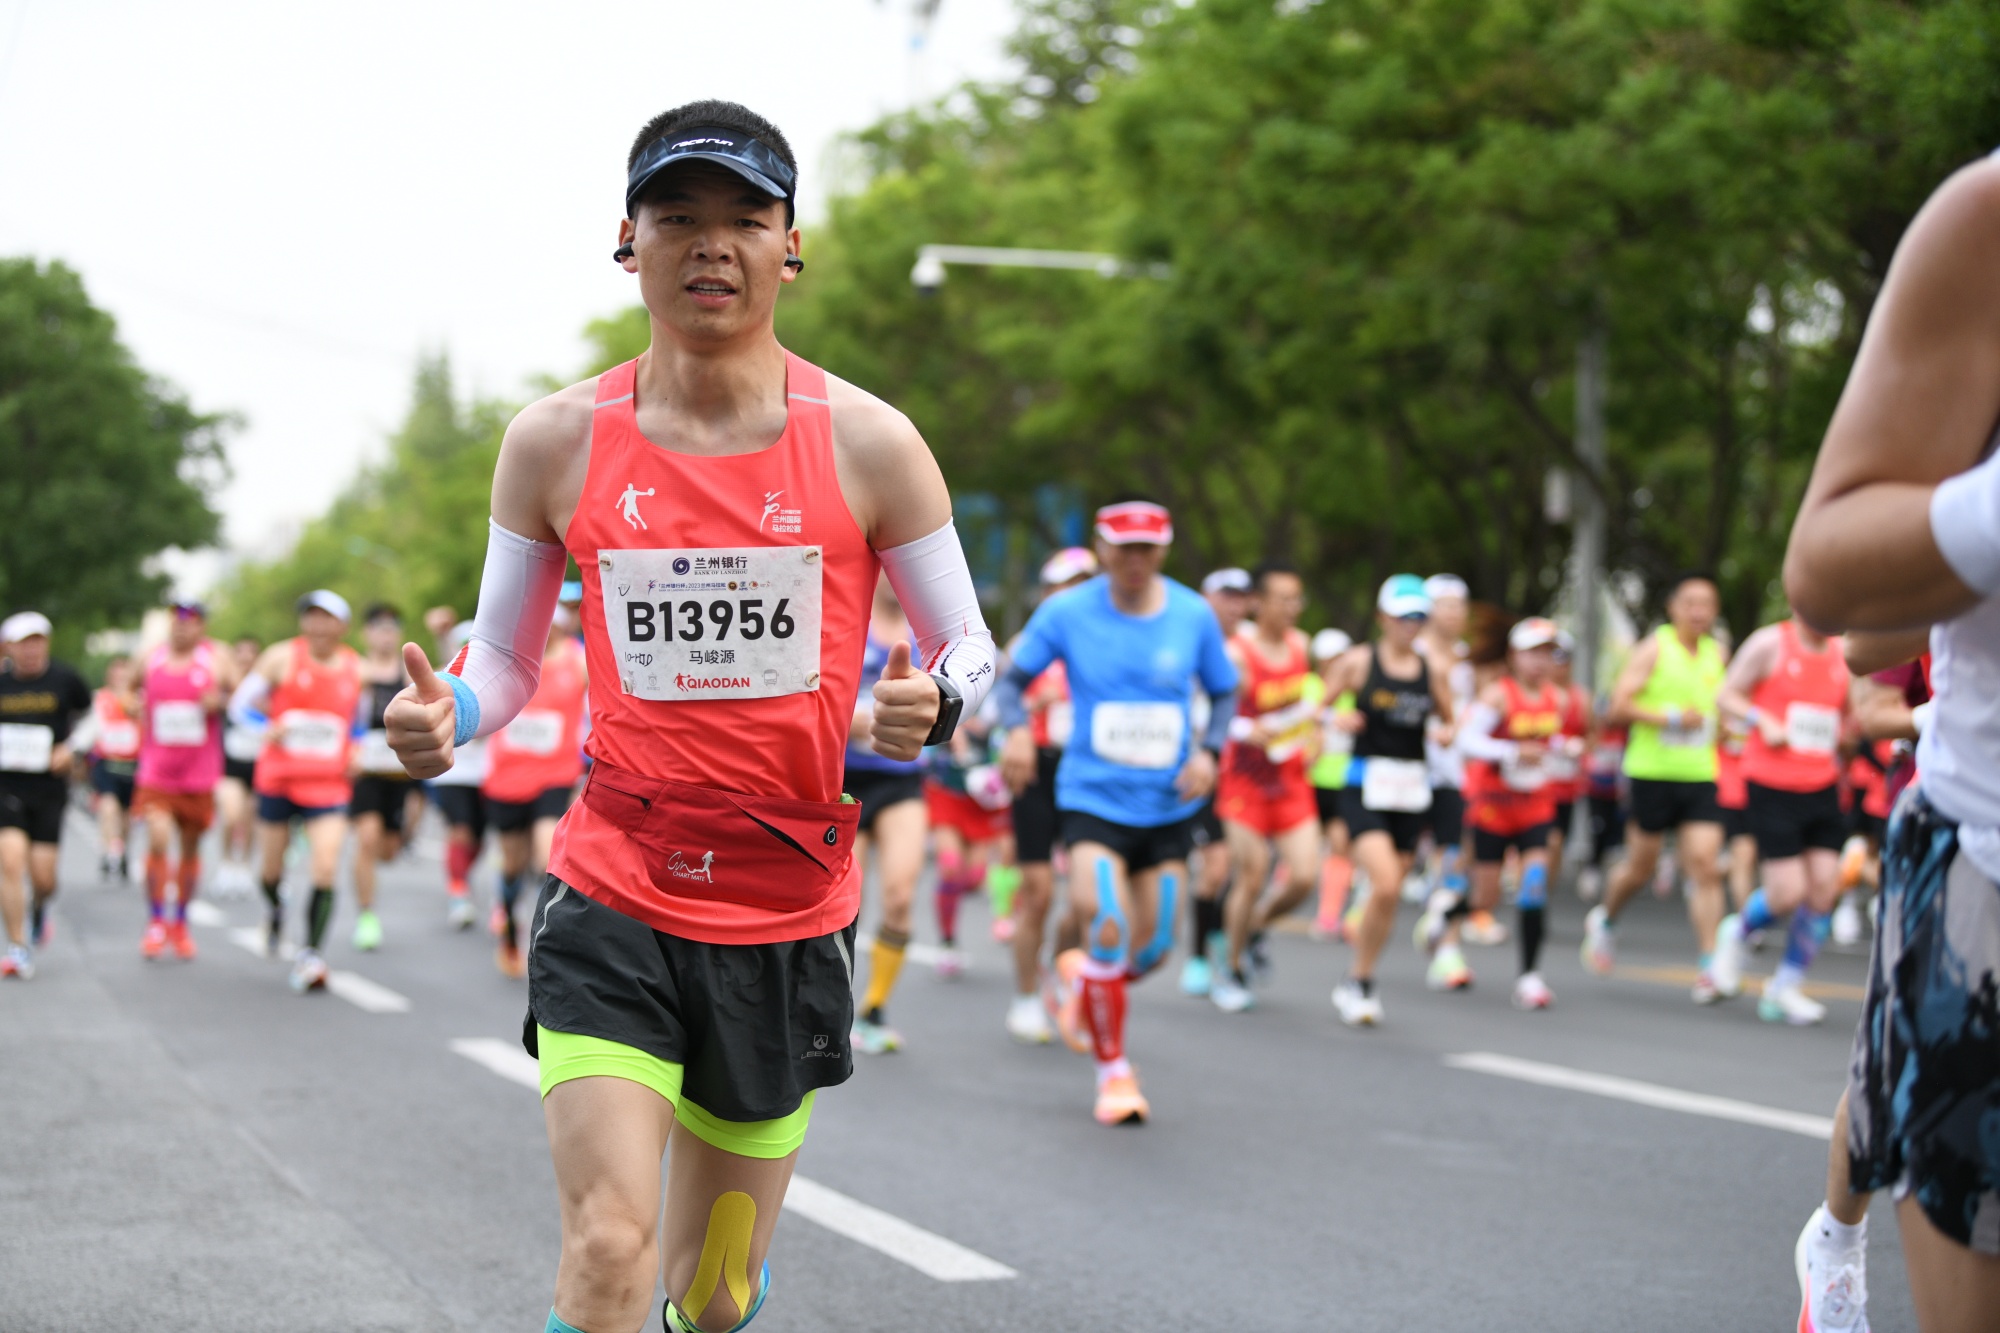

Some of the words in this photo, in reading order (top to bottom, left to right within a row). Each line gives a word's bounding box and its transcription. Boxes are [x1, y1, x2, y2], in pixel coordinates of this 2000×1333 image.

[772, 515, 802, 524] 兰州国际
[772, 524, 802, 533] 马拉松赛
[694, 556, 748, 569] 兰州银行
[627, 598, 795, 642] B13956
[689, 649, 736, 665] 马峻源
[687, 677, 750, 689] QIAODAN
[672, 871, 691, 879] CHART
[800, 1050, 841, 1060] LEEVY
